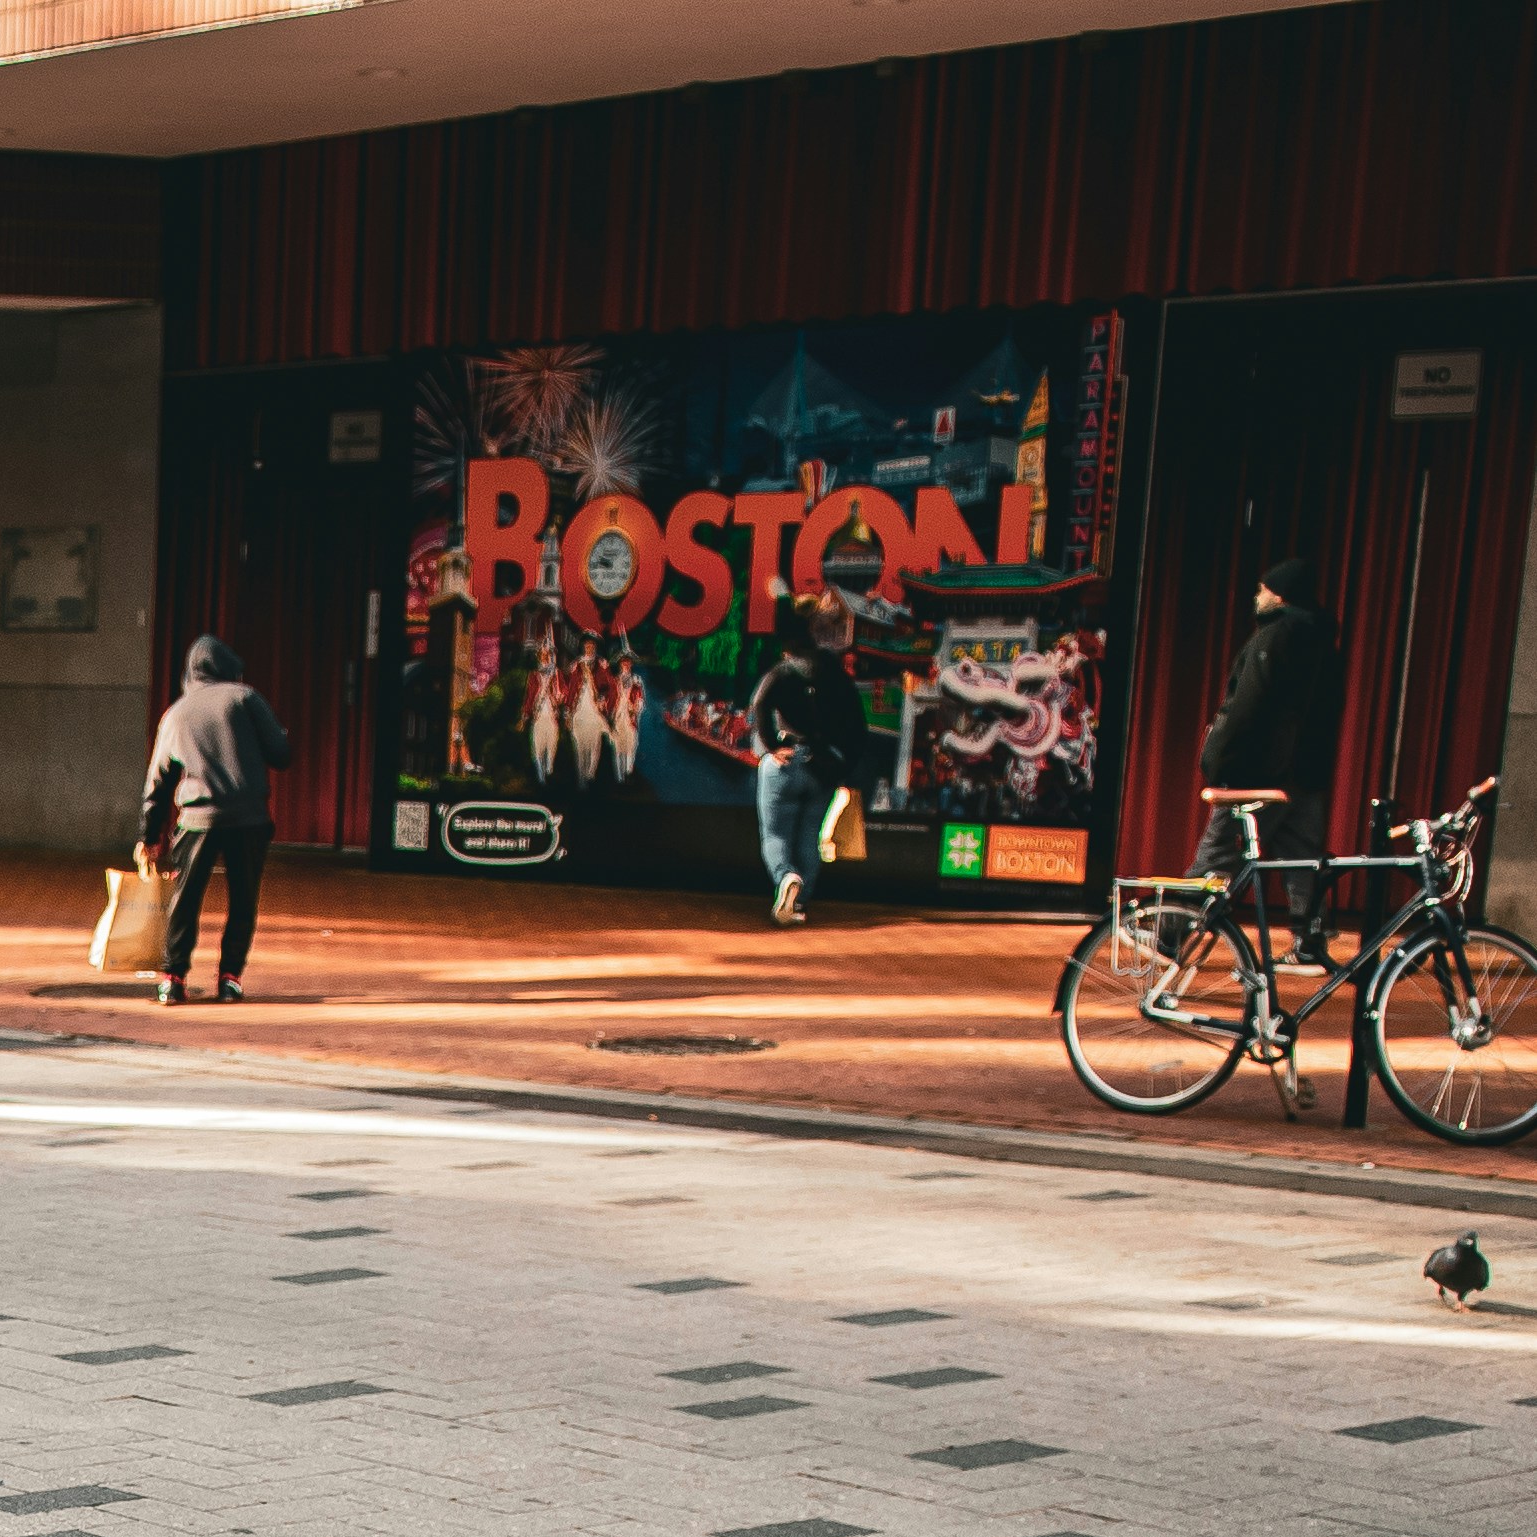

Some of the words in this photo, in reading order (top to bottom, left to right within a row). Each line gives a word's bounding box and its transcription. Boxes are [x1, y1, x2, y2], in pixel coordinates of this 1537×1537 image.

[1424, 365, 1452, 384] NO
[1072, 320, 1106, 571] PARAMOUNT
[466, 457, 1035, 637] BOSTON
[997, 833, 1078, 851] DOWNTOWN
[995, 852, 1076, 875] BOSTON
